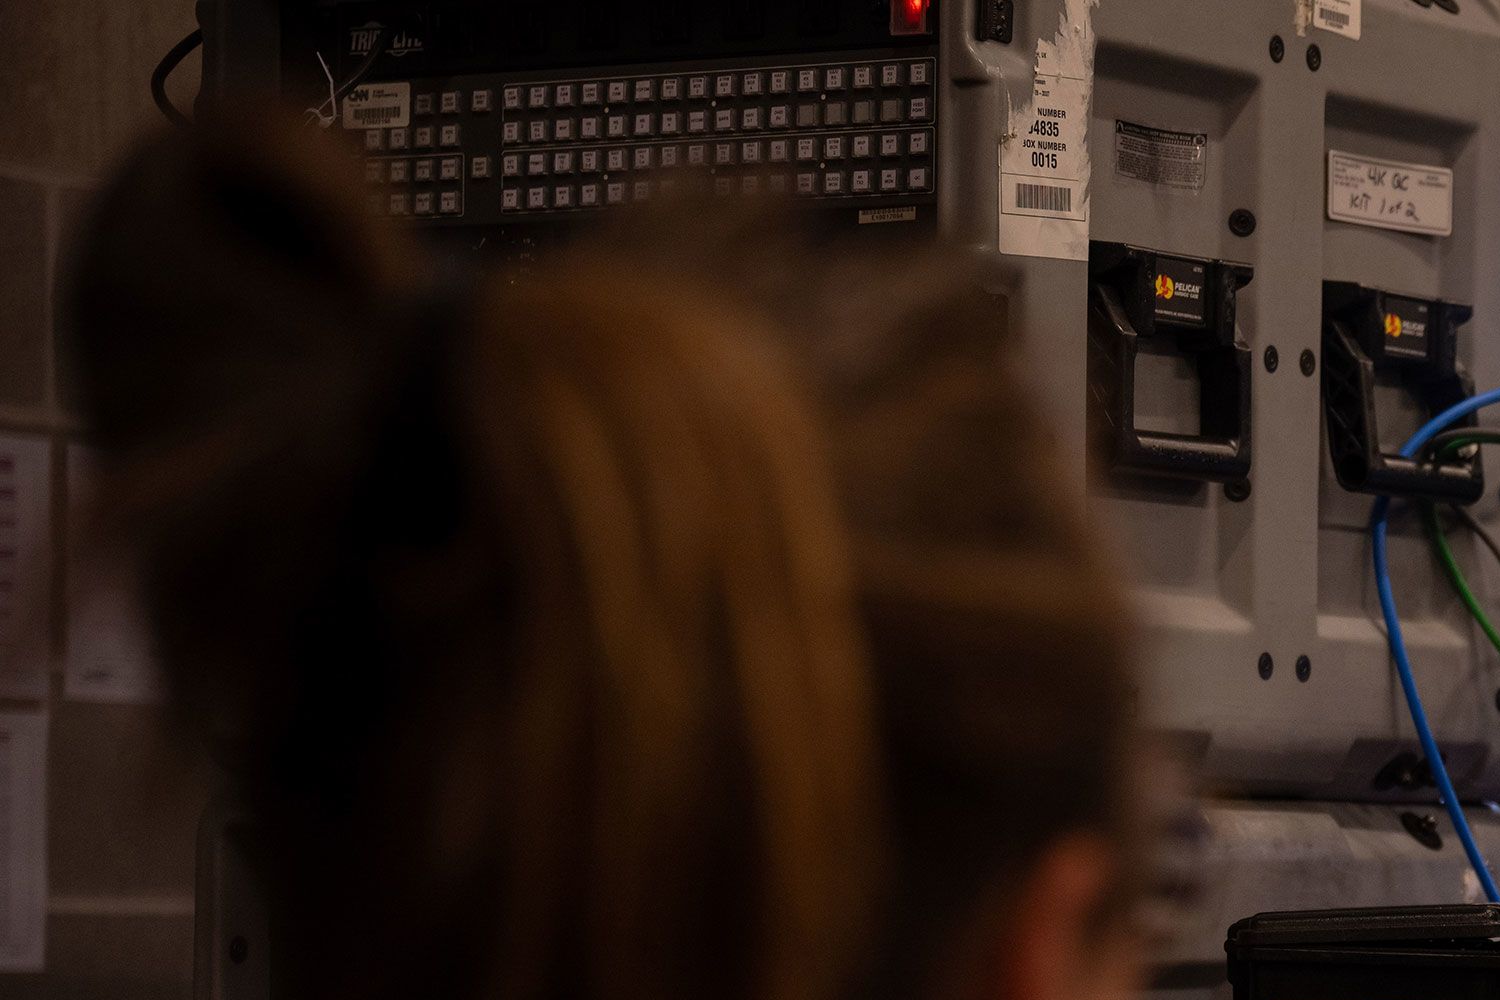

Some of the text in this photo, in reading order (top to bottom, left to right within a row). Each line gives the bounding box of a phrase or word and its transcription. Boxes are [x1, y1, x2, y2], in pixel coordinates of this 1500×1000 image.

[1037, 107, 1067, 119] NUMBER
[1038, 140, 1067, 152] NUMBER
[1032, 151, 1058, 169] 0015
[1350, 193, 1372, 213] KIT
[1175, 282, 1200, 293] PELICAN
